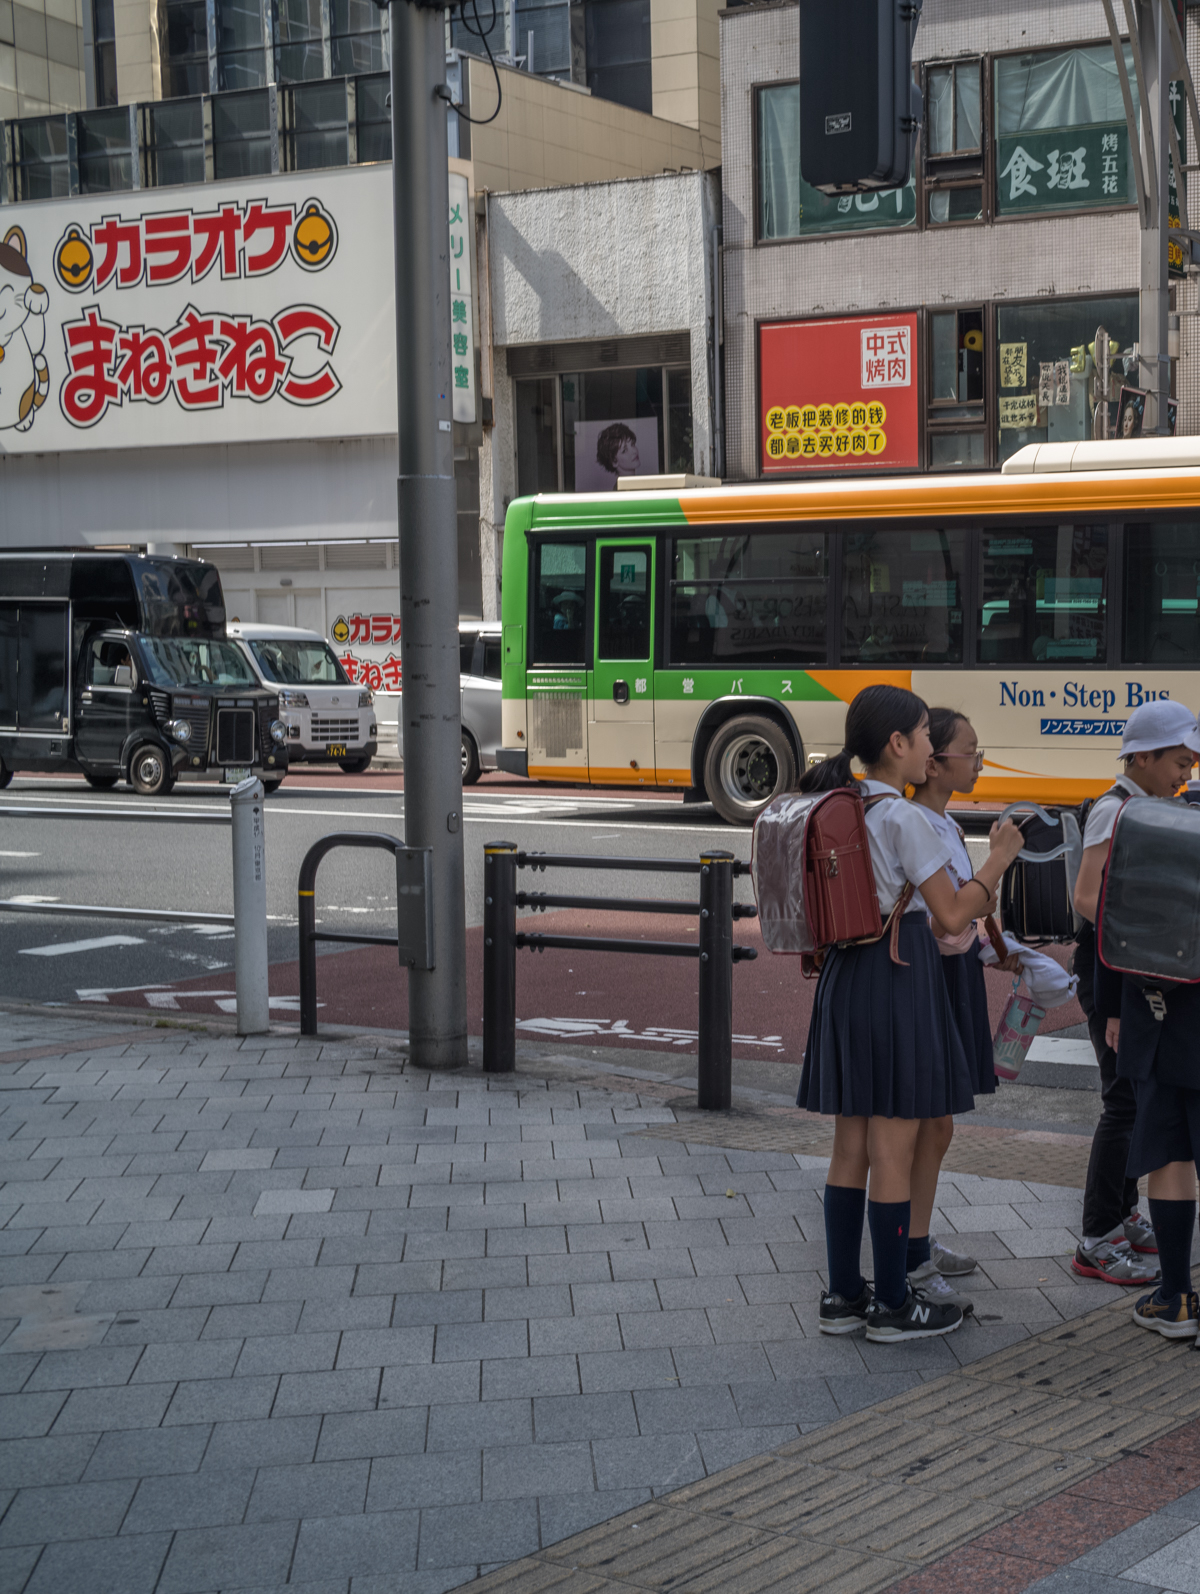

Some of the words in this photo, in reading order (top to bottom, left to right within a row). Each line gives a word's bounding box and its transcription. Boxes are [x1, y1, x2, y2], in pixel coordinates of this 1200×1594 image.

[1101, 133, 1118, 194] 烤五花
[92, 200, 295, 292] カラオケ
[450, 203, 469, 389] メリー美容室
[60, 303, 342, 428] まねきねこ
[866, 332, 906, 356] 中式
[866, 358, 906, 383] 烤肉
[770, 407, 883, 430] 老板把装修的钱
[770, 433, 881, 455] 都拿去买好肉了
